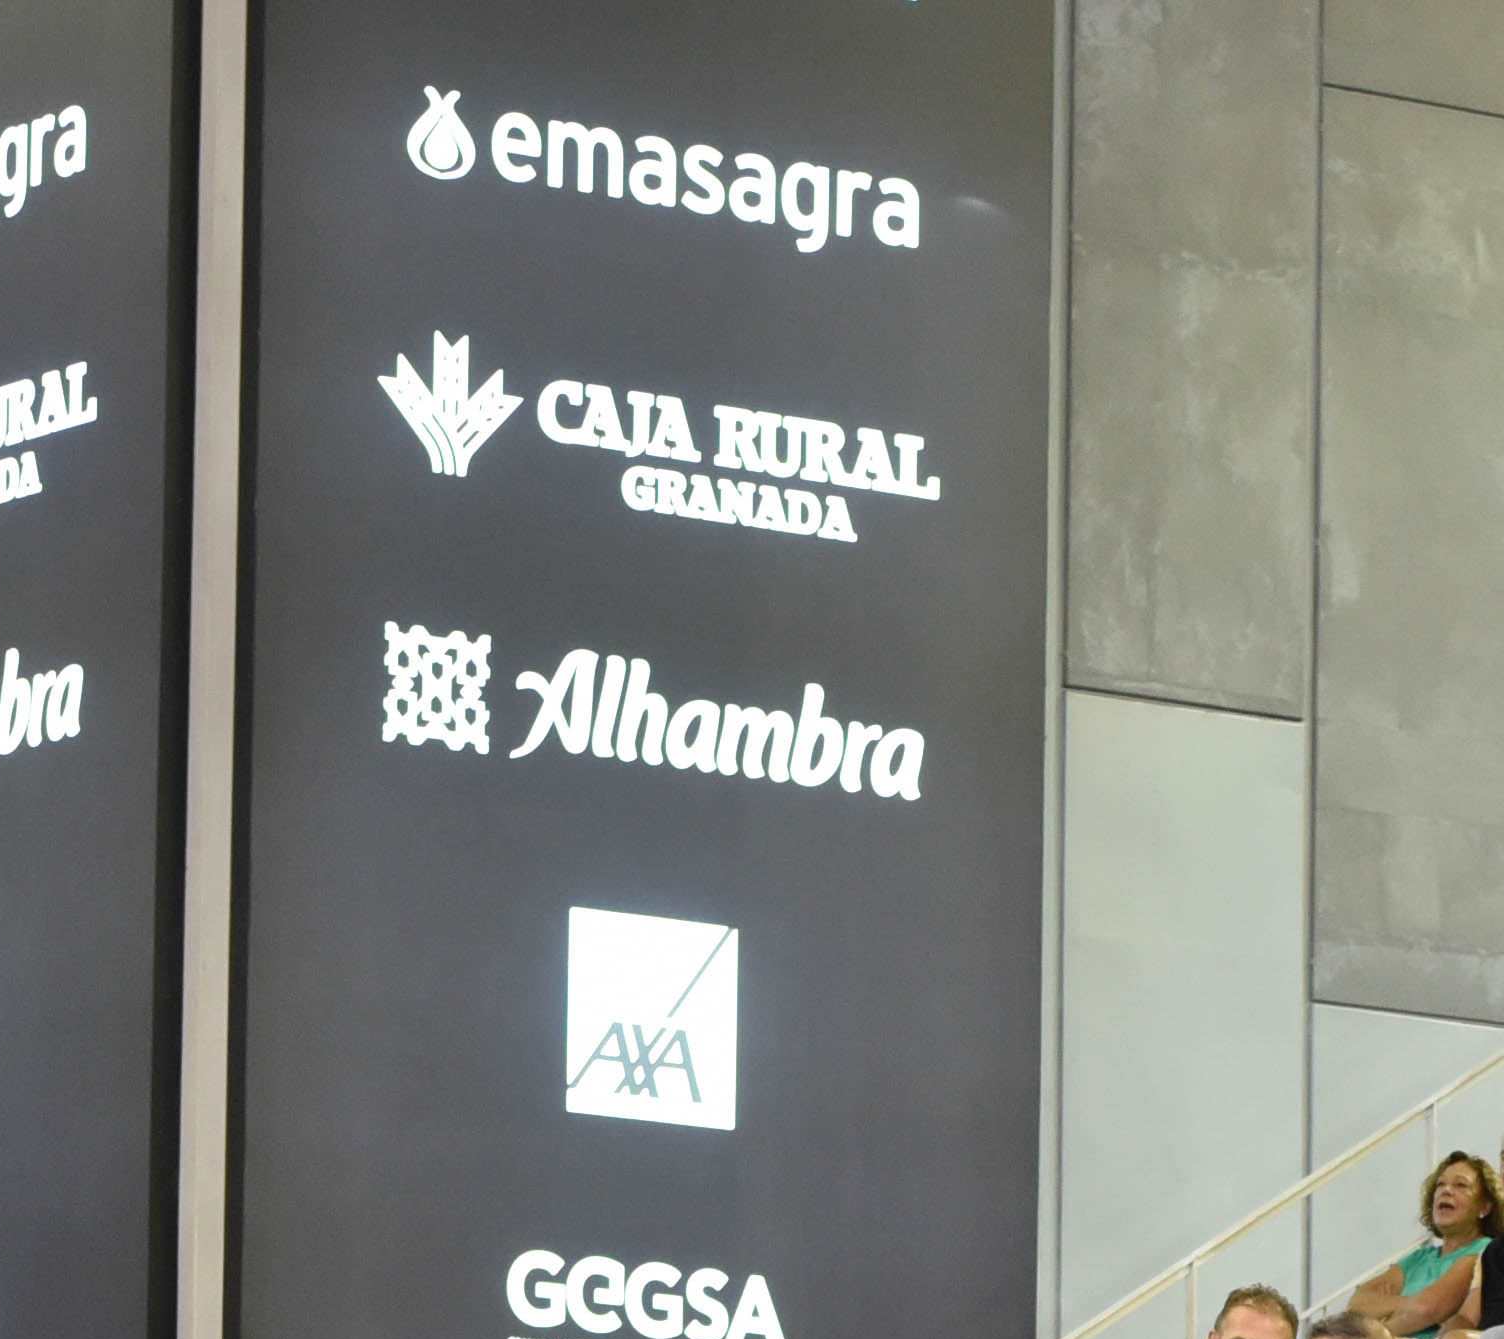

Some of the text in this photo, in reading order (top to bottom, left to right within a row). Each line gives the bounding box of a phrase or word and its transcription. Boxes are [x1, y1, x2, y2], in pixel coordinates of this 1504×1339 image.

[492, 112, 919, 252] emasagra
[537, 380, 940, 500] CAJA RURAL
[621, 466, 857, 542] GRANADA
[509, 649, 924, 801] Alhambra
[573, 1021, 702, 1102] AXA
